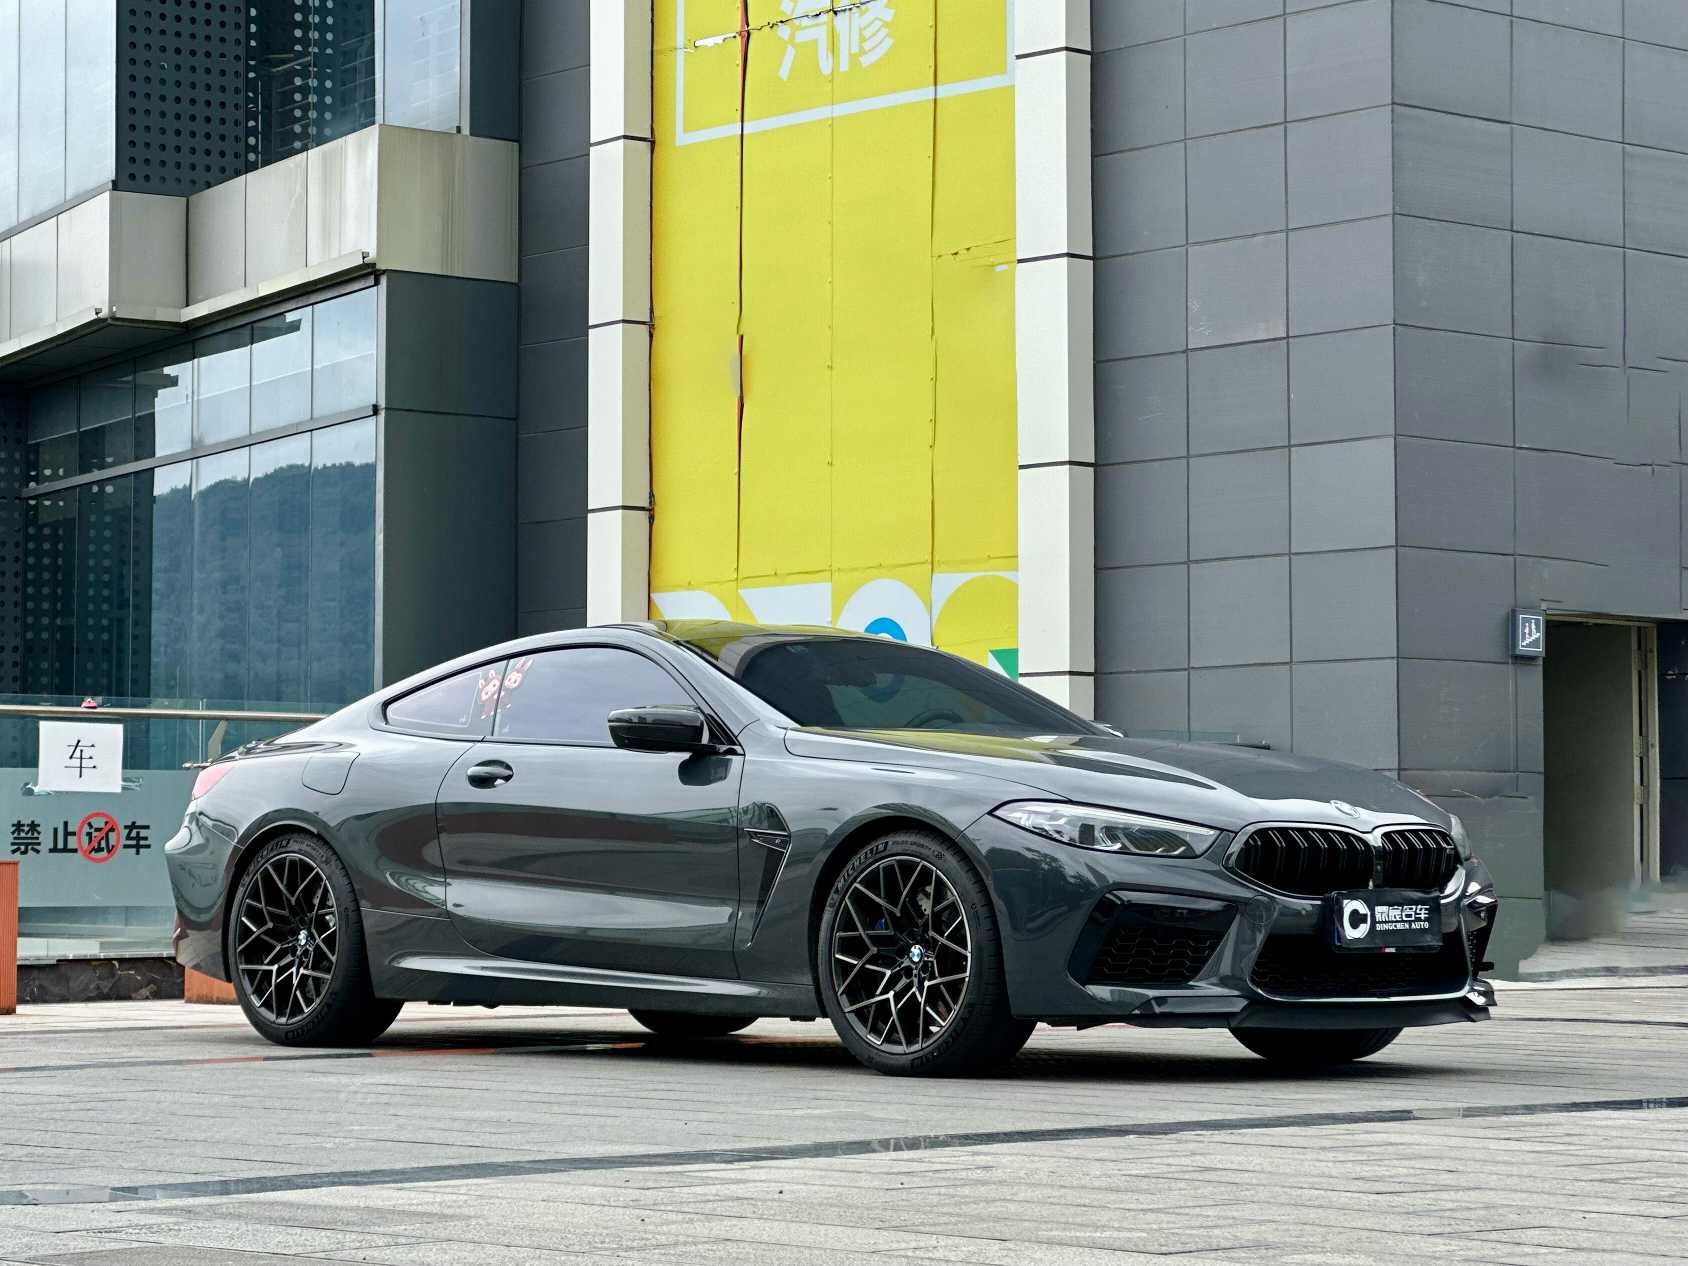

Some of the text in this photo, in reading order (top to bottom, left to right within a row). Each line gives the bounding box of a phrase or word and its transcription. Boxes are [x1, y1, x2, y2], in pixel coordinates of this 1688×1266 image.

[64, 739, 96, 778] 车
[10, 820, 152, 855] 禁止试车
[1375, 921, 1429, 931] DINGCHEN AUTO
